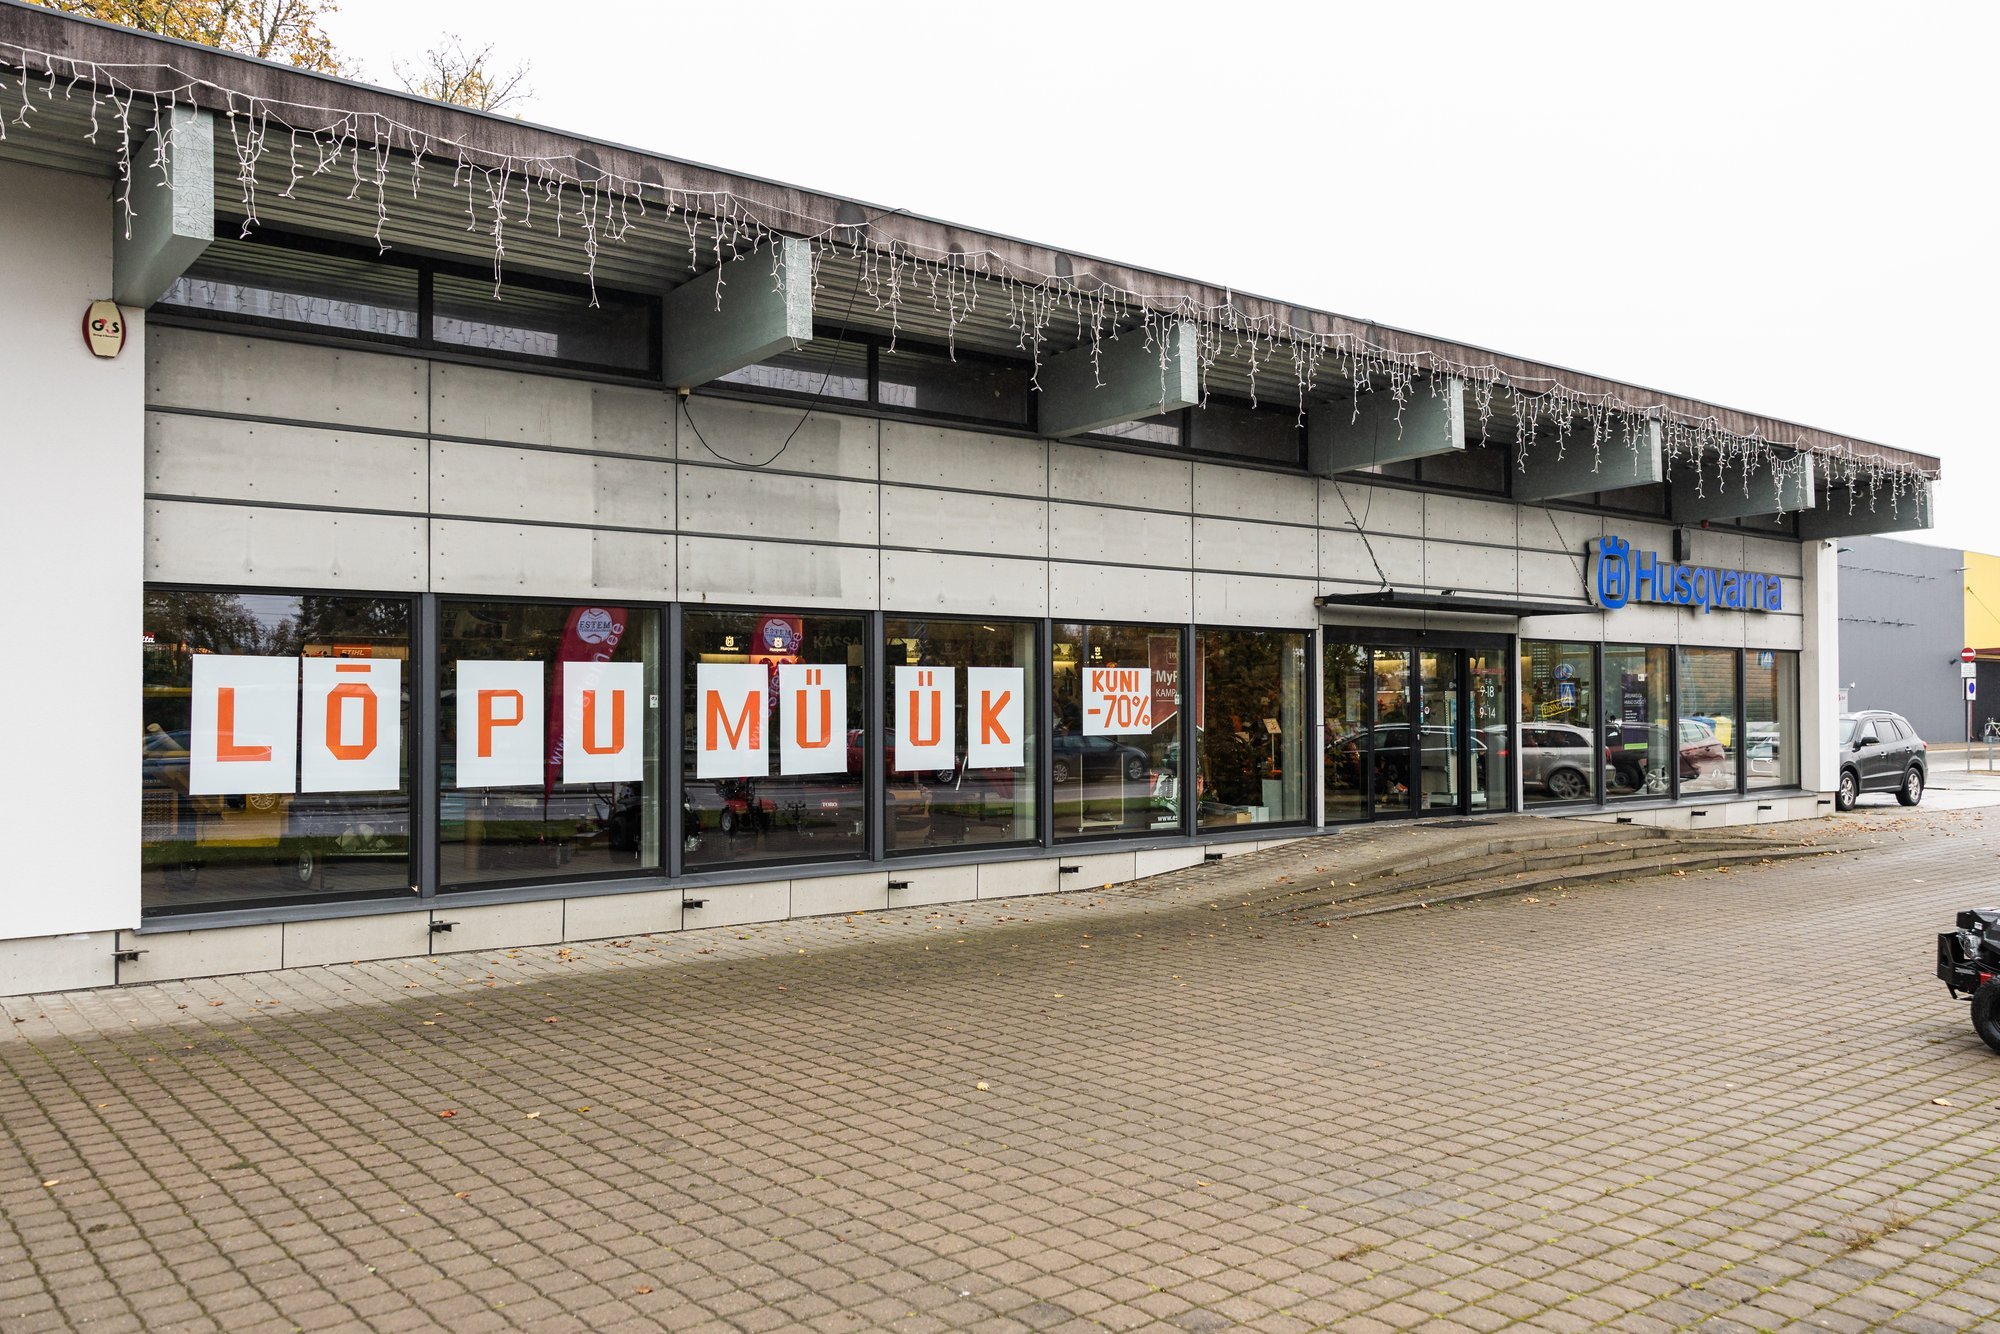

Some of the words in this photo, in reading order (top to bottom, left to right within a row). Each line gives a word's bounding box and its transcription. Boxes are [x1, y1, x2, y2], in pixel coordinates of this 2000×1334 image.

[1635, 550, 1782, 614] Husqvarna
[580, 620, 611, 629] ESTEM
[1091, 670, 1139, 693] KUNI
[1479, 685, 1495, 698] 9-18
[1087, 694, 1151, 729] -70%
[1479, 706, 1496, 719] 9-14
